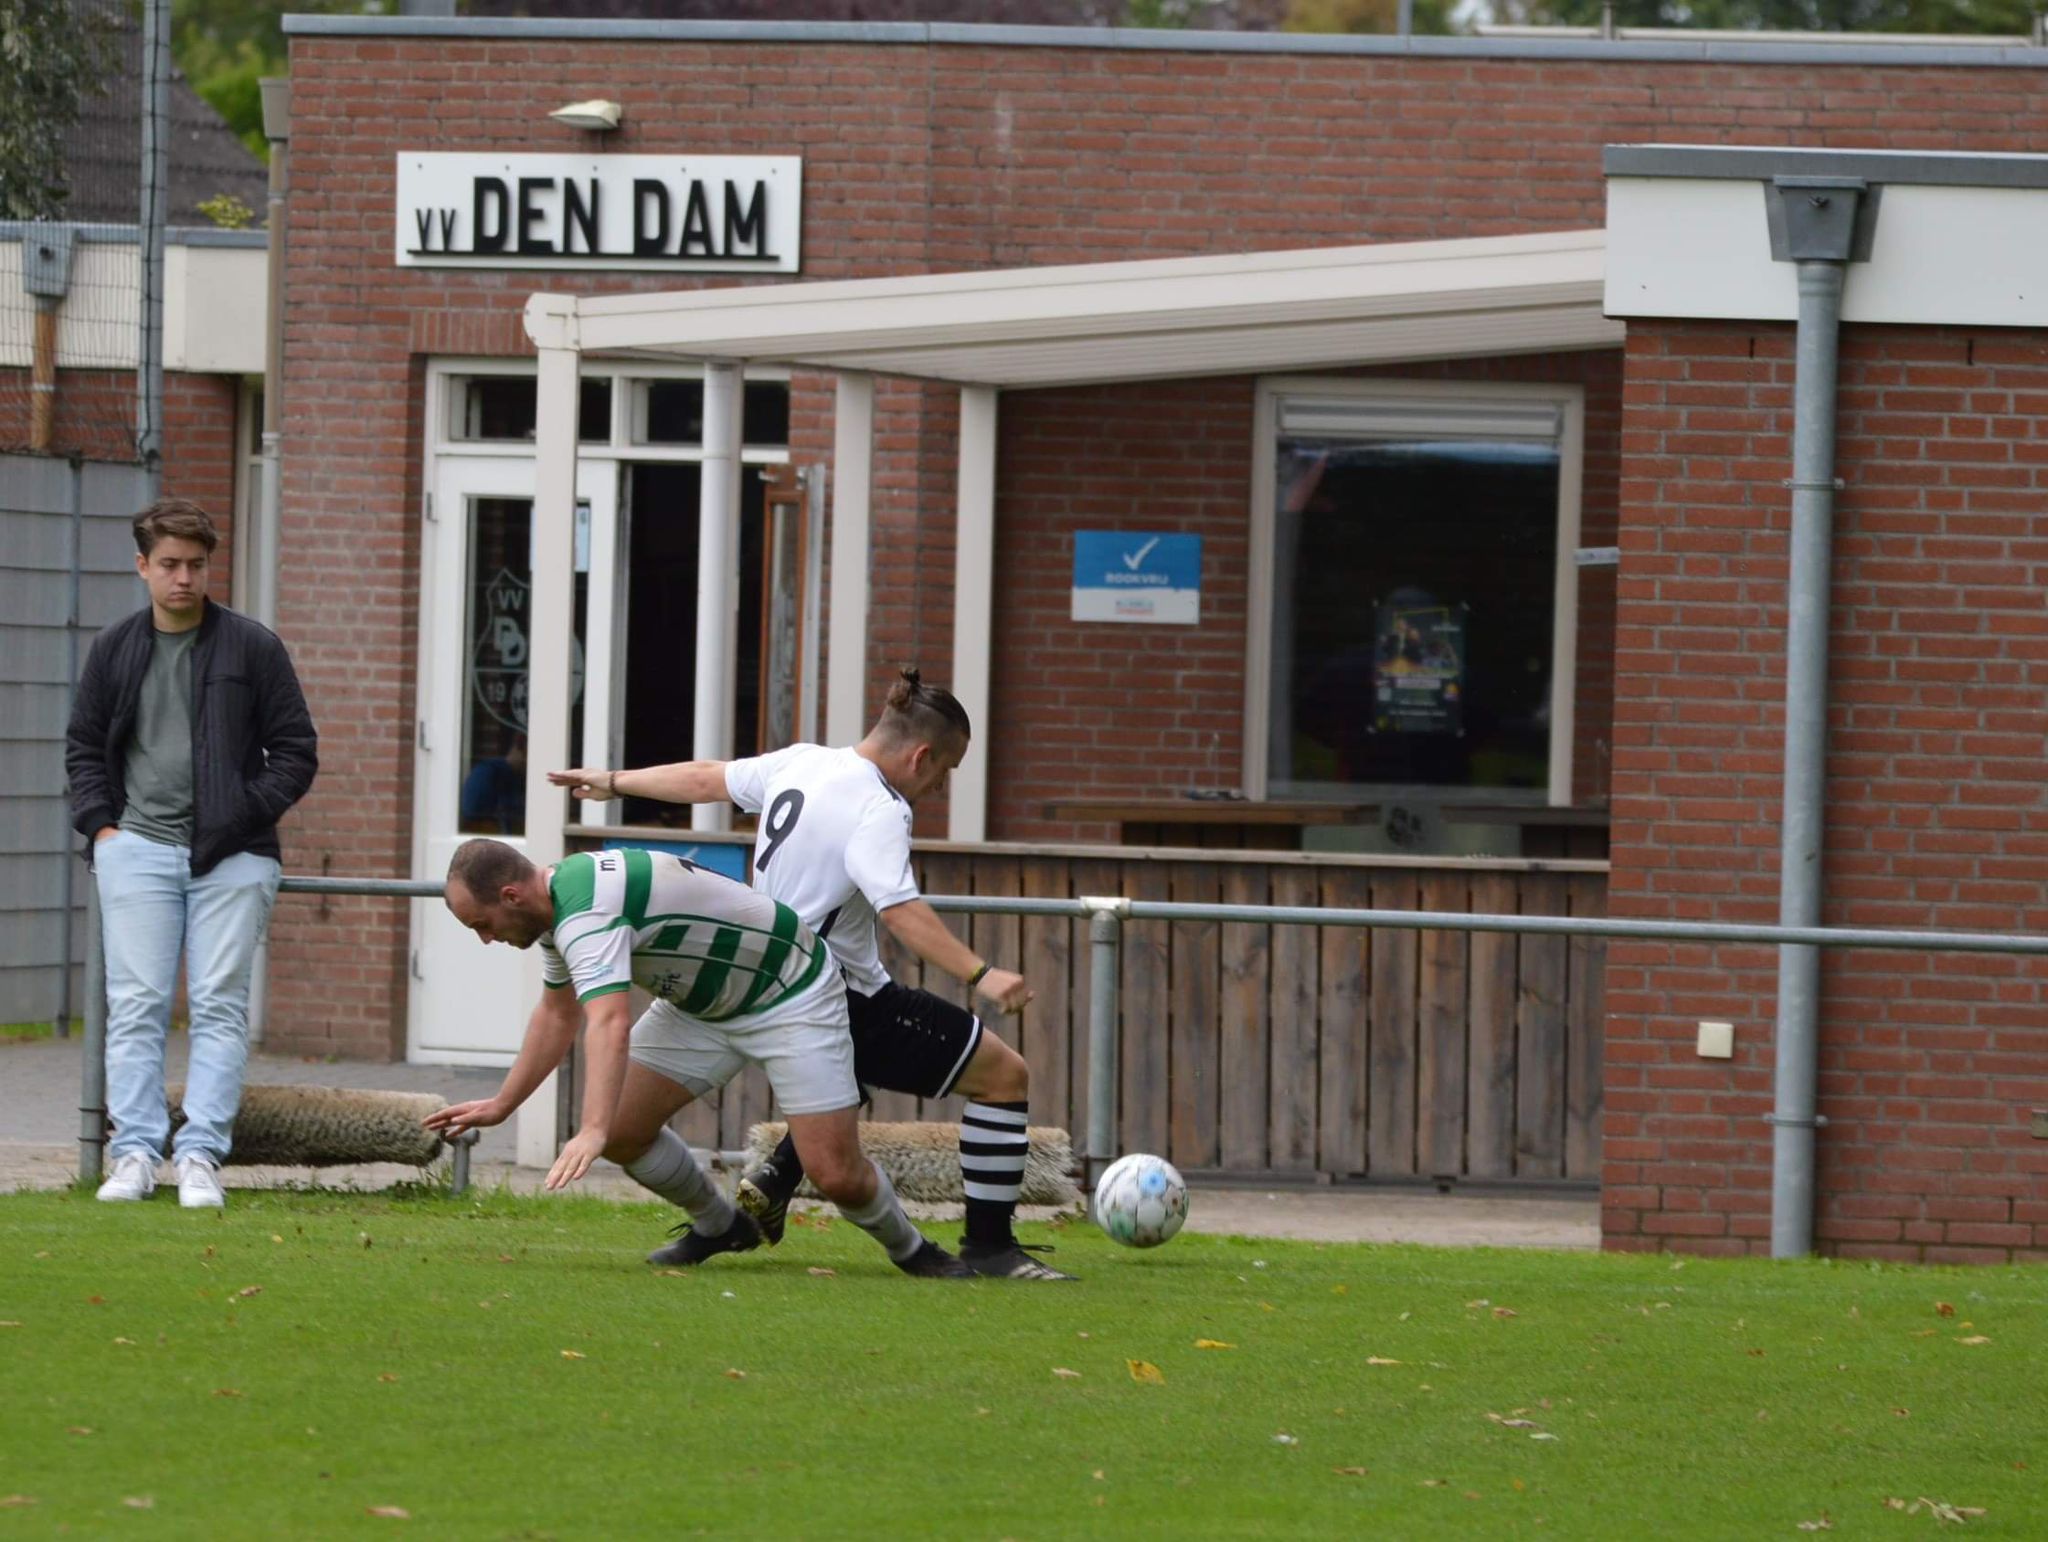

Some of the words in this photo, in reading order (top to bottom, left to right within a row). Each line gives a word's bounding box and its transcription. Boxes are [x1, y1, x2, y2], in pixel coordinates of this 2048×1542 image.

[473, 176, 599, 254] DEN
[633, 178, 766, 256] DAM
[756, 788, 805, 873] 9
